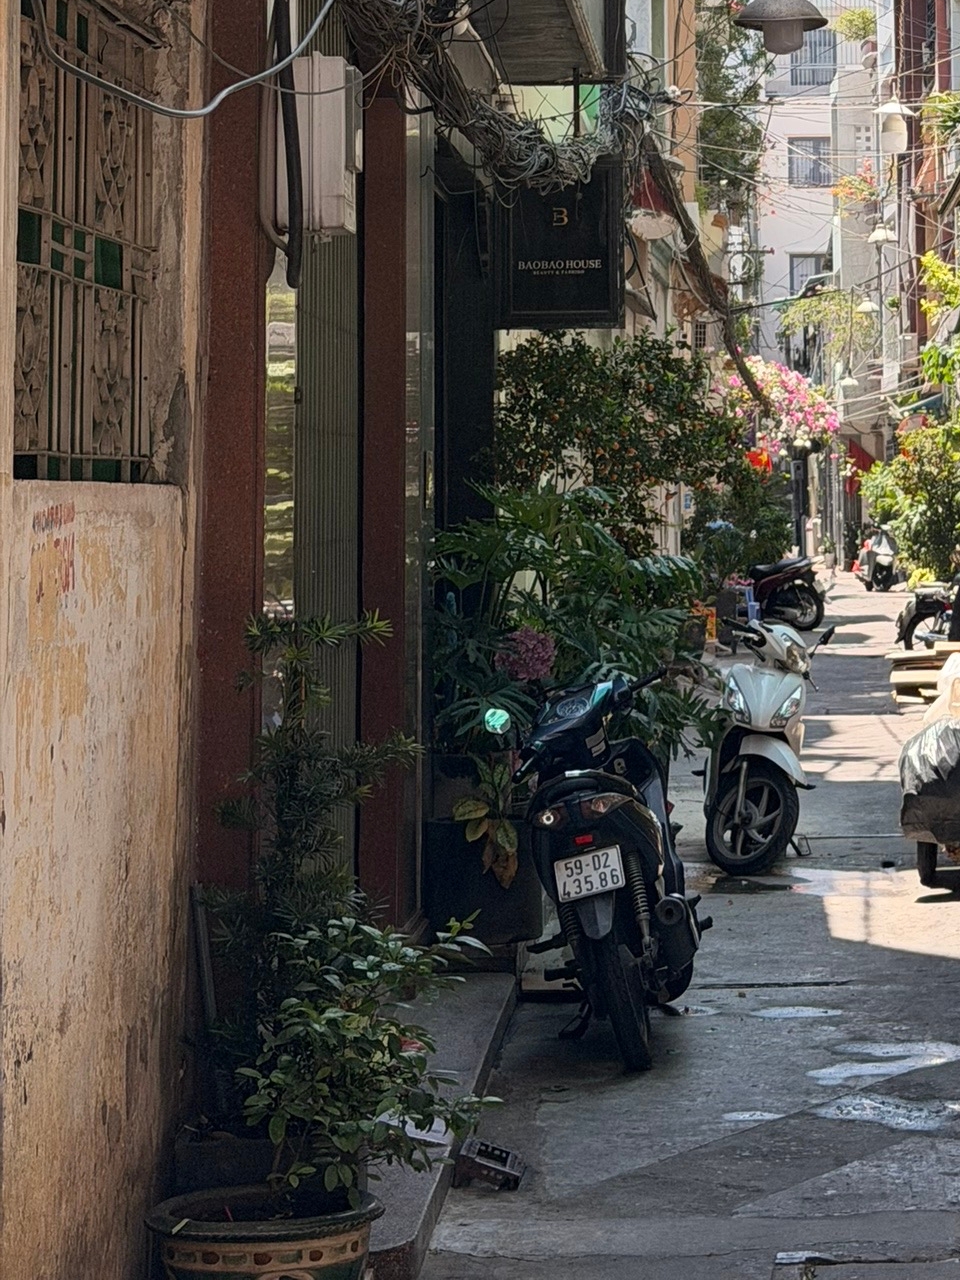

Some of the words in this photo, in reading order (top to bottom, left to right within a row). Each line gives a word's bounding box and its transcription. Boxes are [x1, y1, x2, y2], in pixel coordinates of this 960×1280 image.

[552, 207, 569, 227] B
[518, 260, 565, 270] BAOBAO
[565, 259, 602, 269] HOUSE
[564, 852, 611, 878] 59-D2
[562, 868, 620, 898] 435.86
